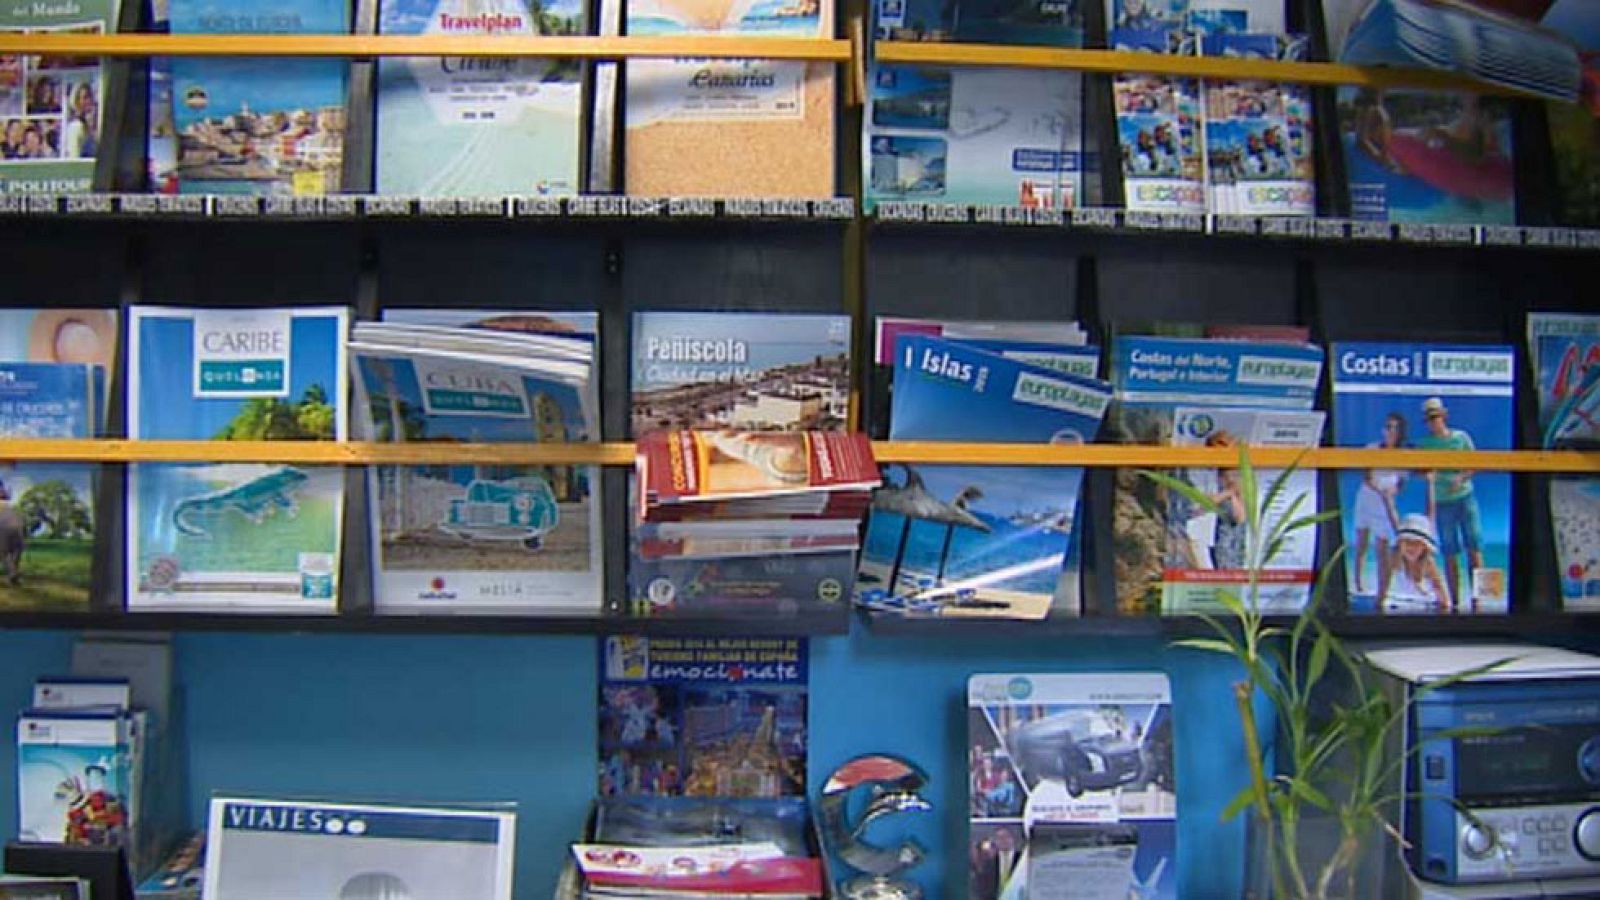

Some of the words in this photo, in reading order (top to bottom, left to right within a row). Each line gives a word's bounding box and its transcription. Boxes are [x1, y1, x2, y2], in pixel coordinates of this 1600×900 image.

[440, 13, 521, 32] Travelplan
[688, 69, 775, 88] Canarias
[203, 332, 283, 352] CARIBE
[921, 348, 974, 381] Islas
[1131, 351, 1172, 364] Costas
[1341, 352, 1409, 376] Costas
[426, 372, 513, 393] CUBA
[651, 662, 799, 682] emocinate
[230, 807, 323, 830] VIAJES
